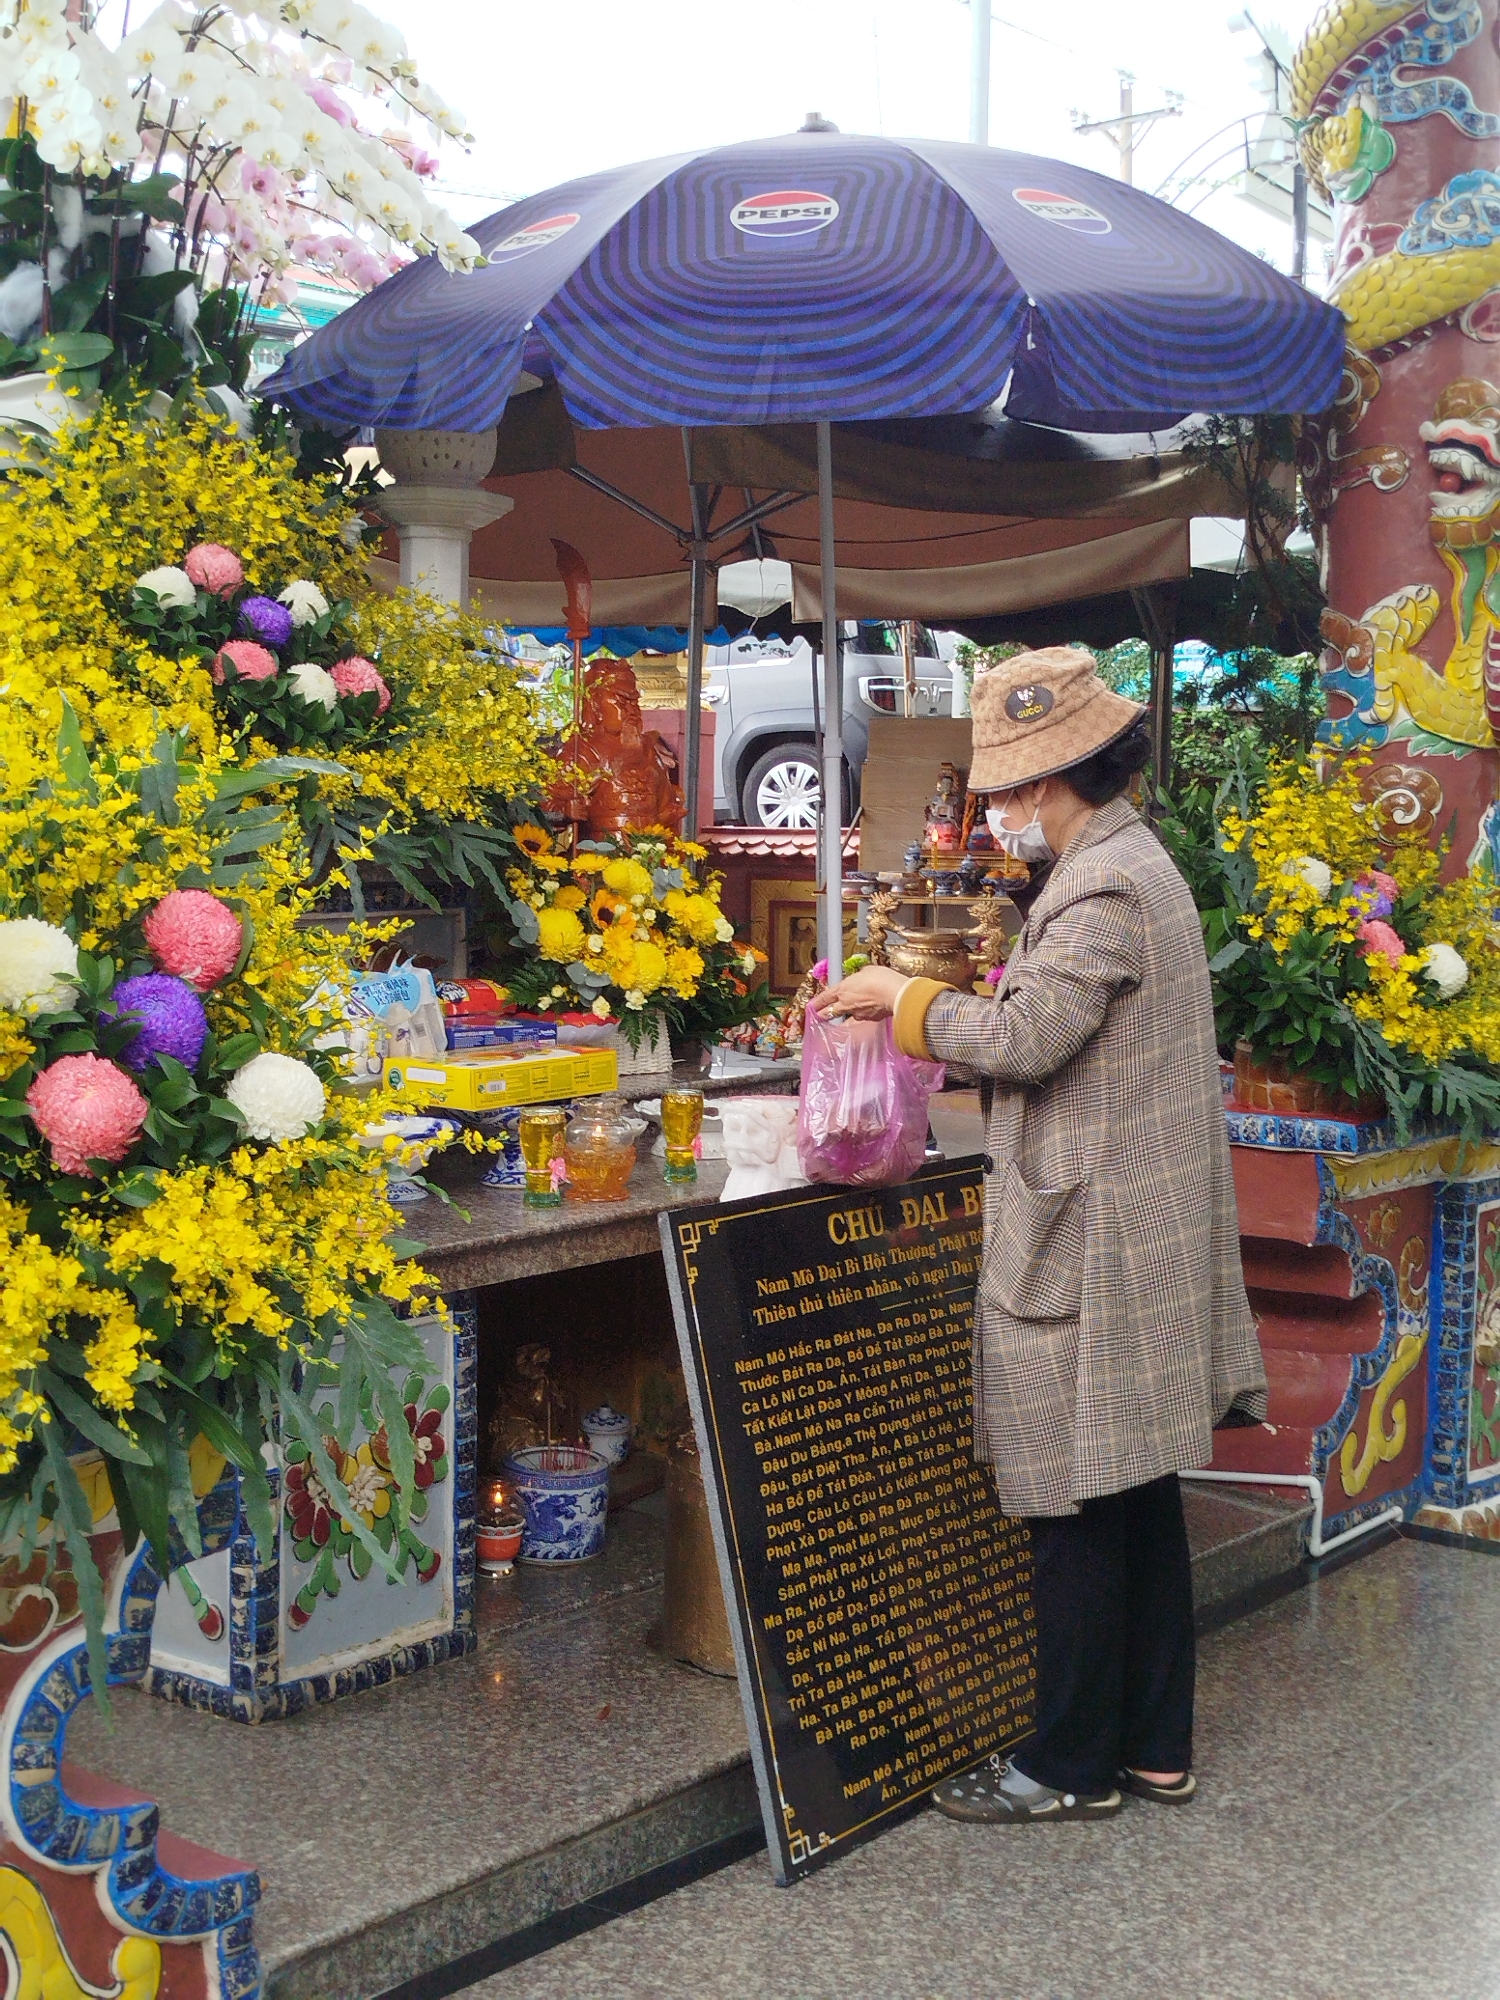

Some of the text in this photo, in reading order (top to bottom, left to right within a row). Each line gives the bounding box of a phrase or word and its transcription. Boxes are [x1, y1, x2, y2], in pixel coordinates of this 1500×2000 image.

[737, 206, 832, 220] PEPSI
[1016, 704, 1044, 719] GUCCI
[900, 1191, 949, 1232] ĐẠI
[756, 1278, 789, 1296] Nam
[817, 1262, 842, 1284] Đại
[844, 1257, 860, 1274] Bi
[862, 1253, 886, 1273] Hội
[888, 1243, 936, 1264] Thượng
[938, 1234, 967, 1254] Phật
[752, 1303, 796, 1325] Thiên
[799, 1293, 823, 1314] thủ
[826, 1287, 863, 1306] thiên
[904, 1271, 919, 1286] vô
[922, 1263, 949, 1285] ngại
[951, 1260, 973, 1278] Đại
[734, 1358, 763, 1373] Nam
[766, 1348, 786, 1364] Mô
[741, 1401, 760, 1414] Ca
[762, 1393, 778, 1409] Lô
